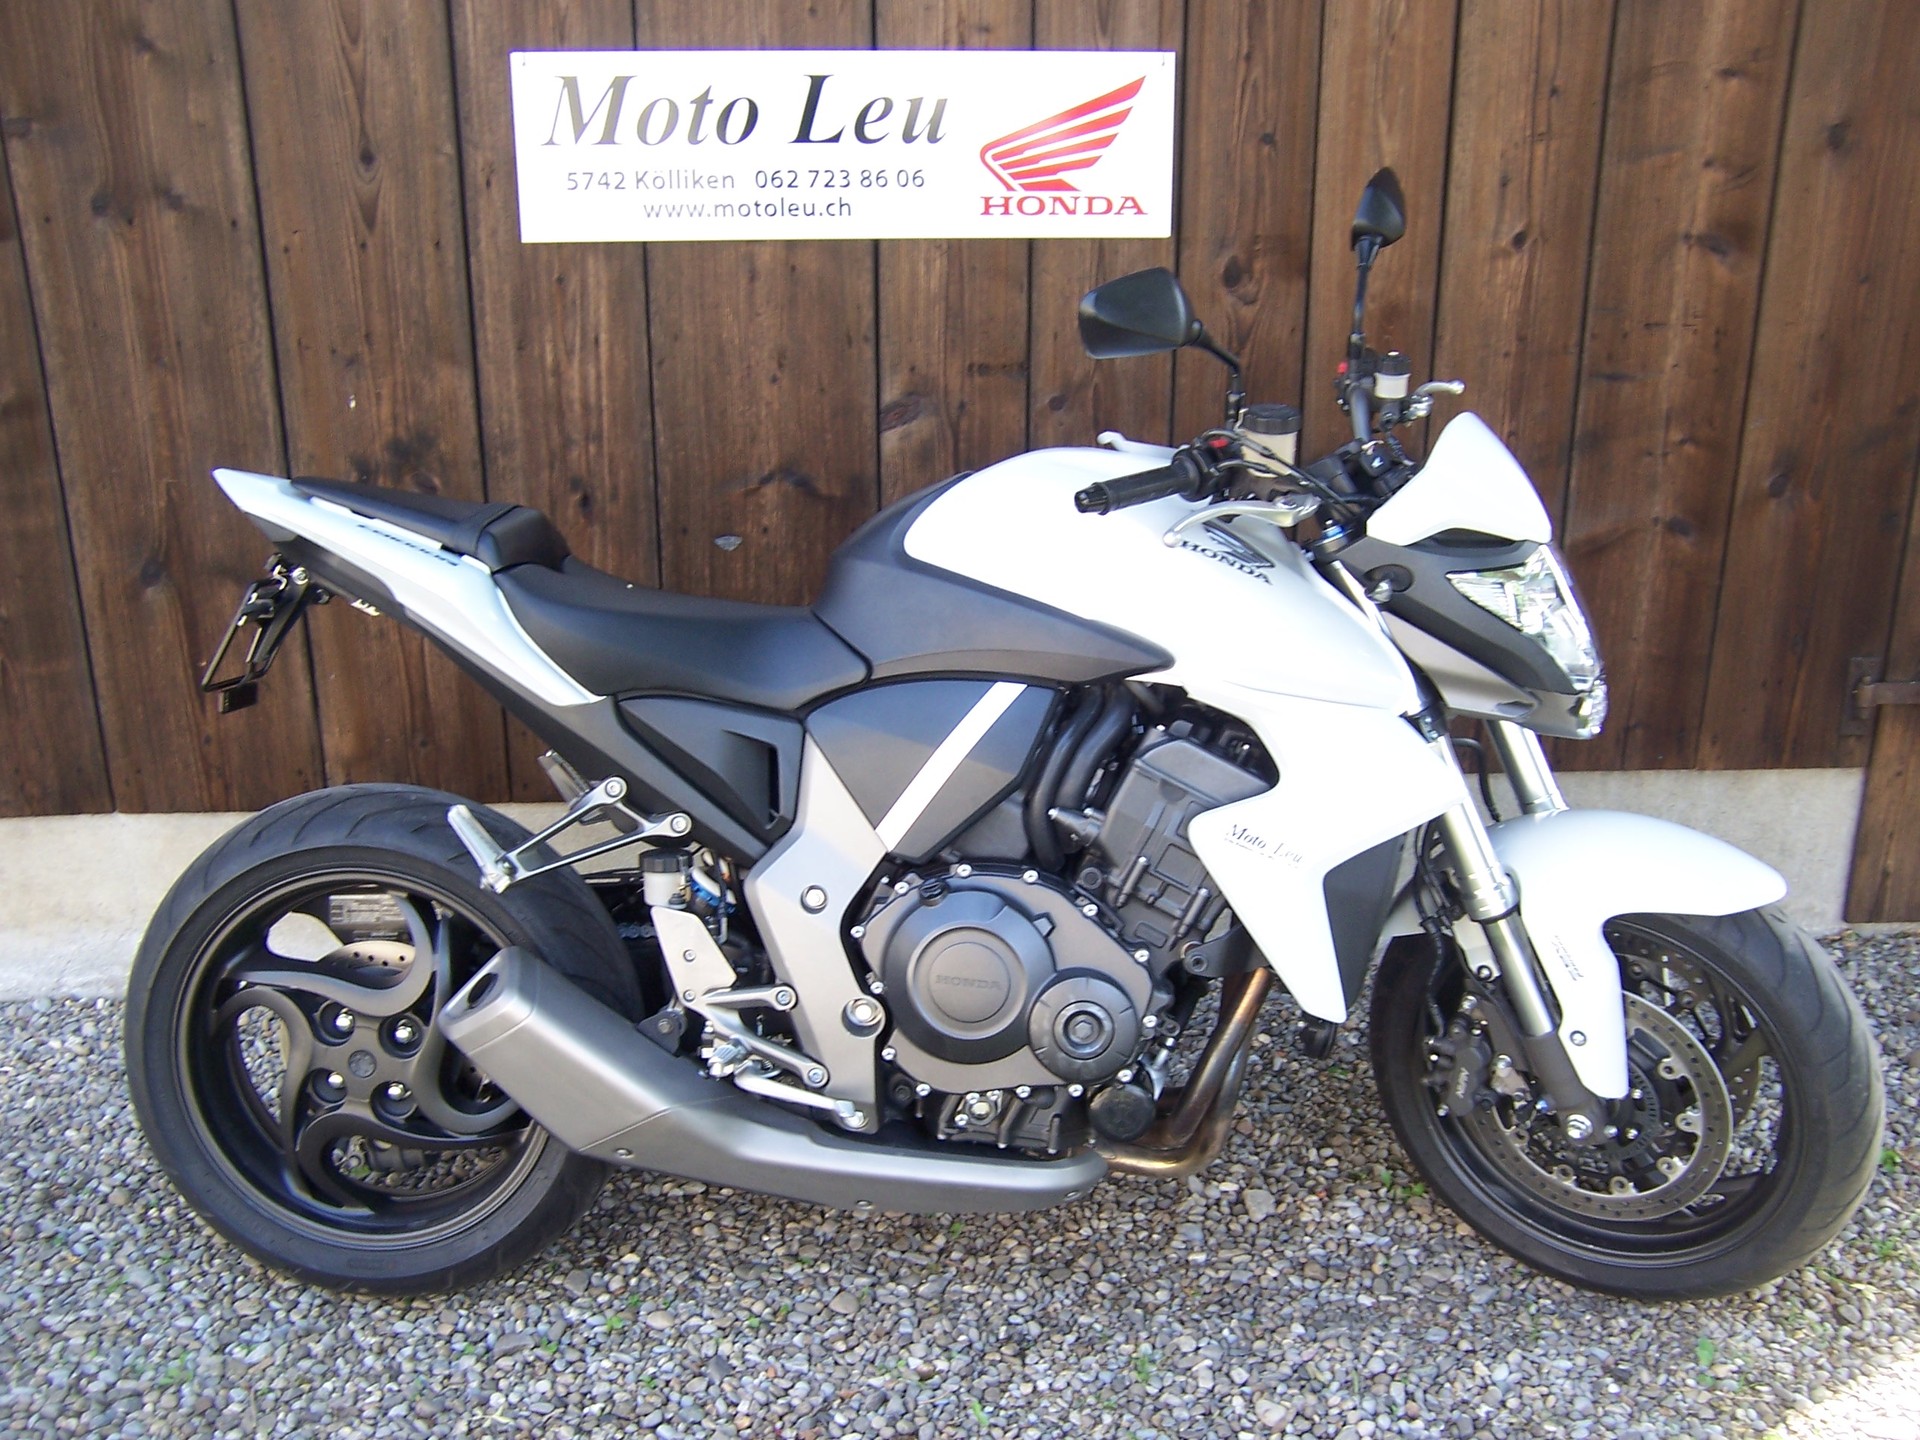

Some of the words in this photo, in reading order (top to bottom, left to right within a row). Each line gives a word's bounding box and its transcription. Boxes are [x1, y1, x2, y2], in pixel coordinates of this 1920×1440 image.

[540, 74, 759, 146] Moto
[787, 74, 949, 145] Leu
[566, 171, 627, 191] 5742
[635, 168, 735, 190] Kölliken
[754, 169, 799, 189] 062
[807, 169, 851, 189] 723
[859, 169, 889, 189] 86
[896, 169, 926, 189] 06
[643, 196, 852, 218] www.motoleu.ch
[980, 195, 1149, 216] HONDA
[1180, 540, 1274, 586] HONDA
[1225, 823, 1267, 849] Moto
[935, 974, 1002, 991] HONDA
